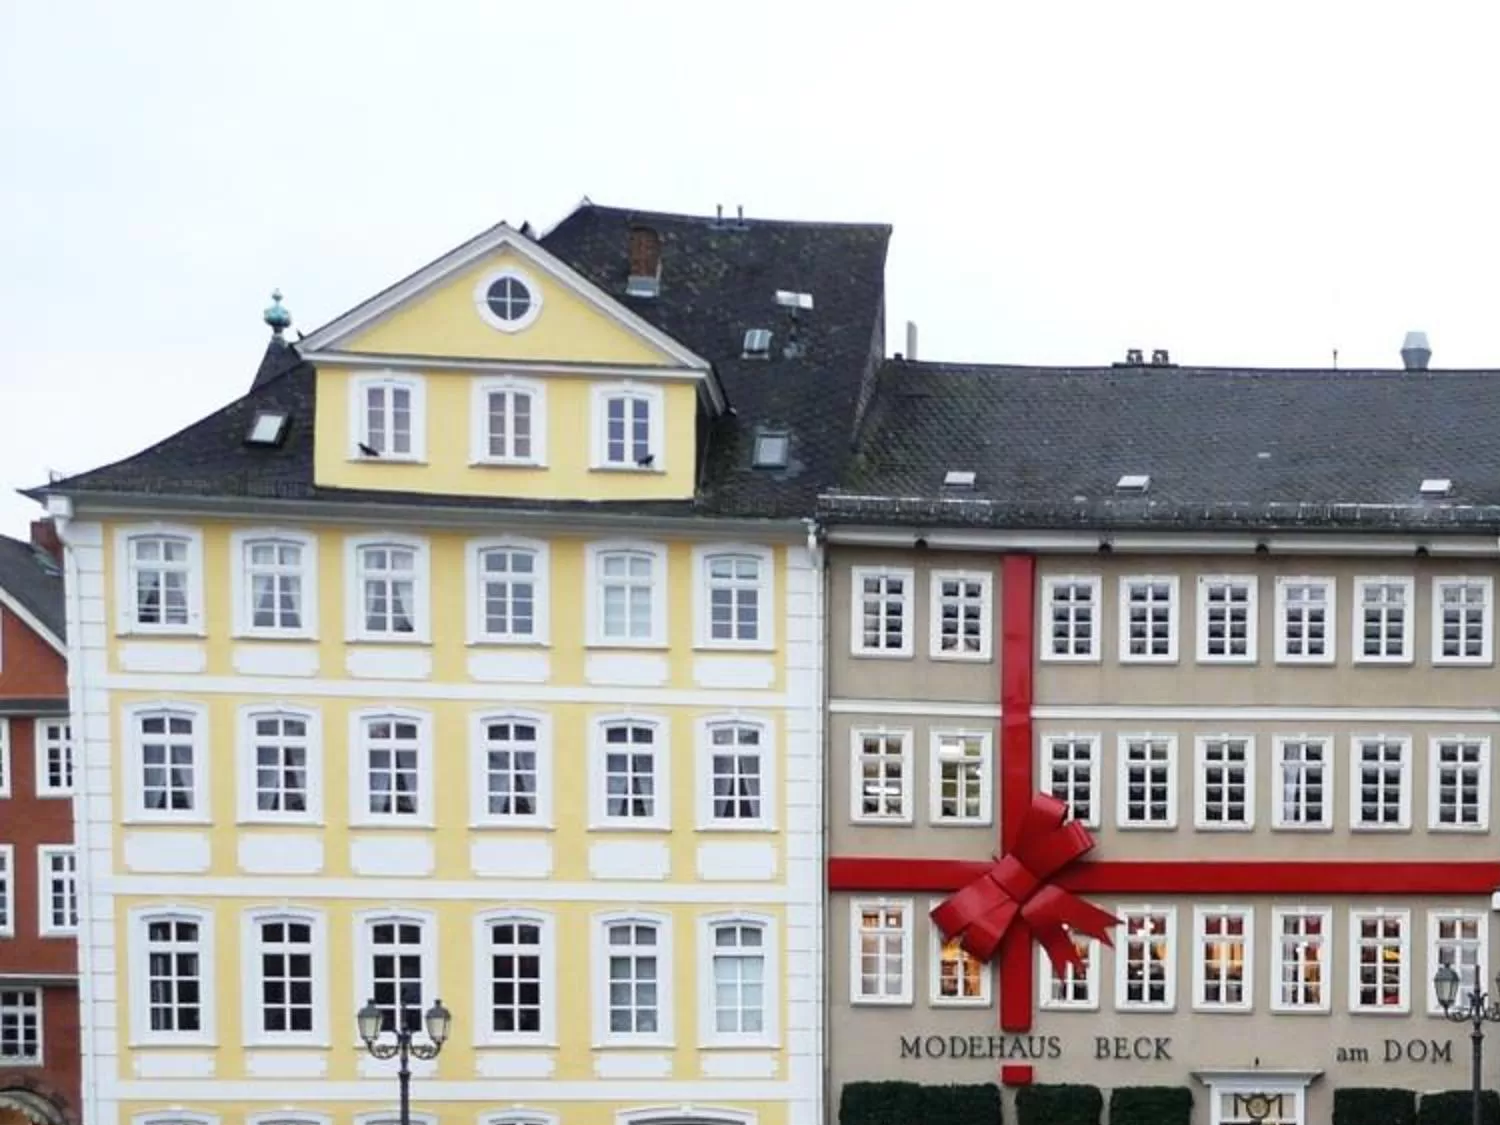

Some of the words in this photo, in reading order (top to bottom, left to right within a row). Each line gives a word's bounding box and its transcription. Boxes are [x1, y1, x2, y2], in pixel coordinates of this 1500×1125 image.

[900, 1036, 1061, 1059] MODEHAUS
[1095, 1037, 1172, 1061] BECK
[1336, 1047, 1368, 1062] am
[1384, 1039, 1452, 1063] DOM
